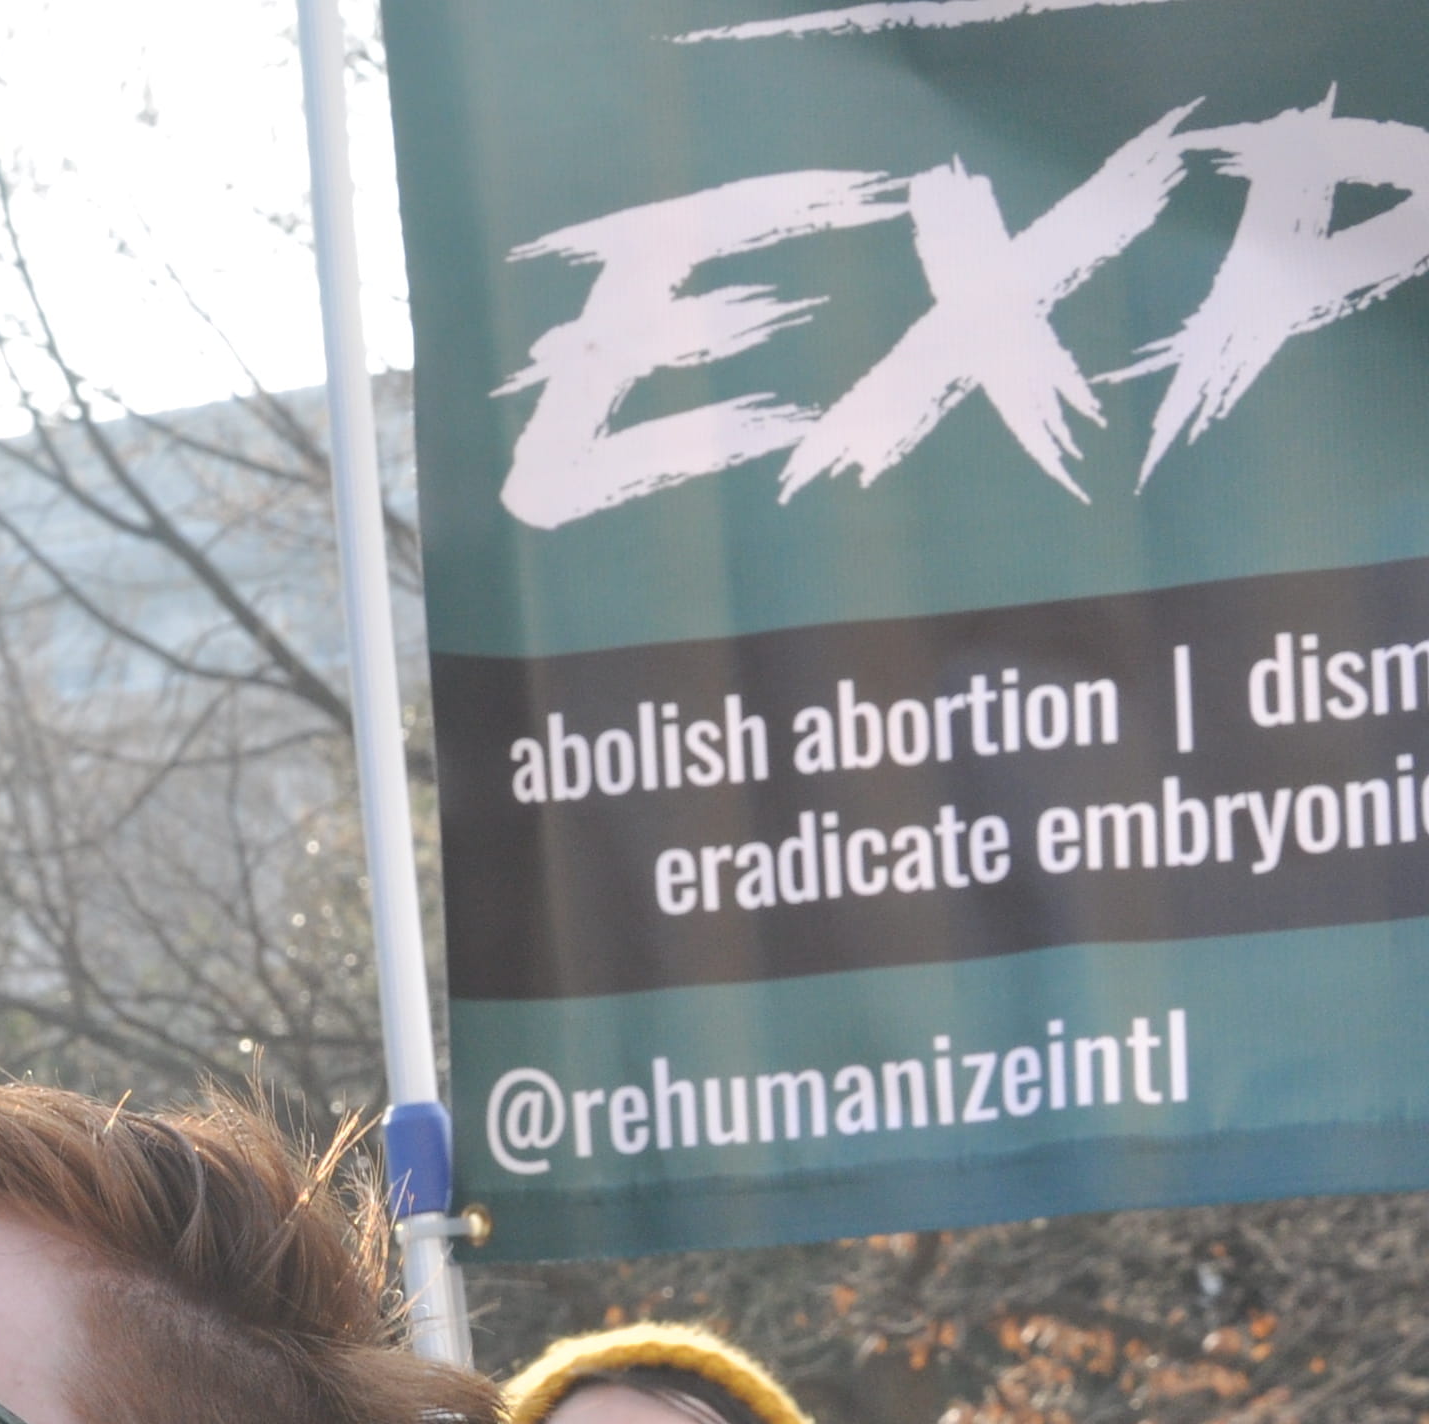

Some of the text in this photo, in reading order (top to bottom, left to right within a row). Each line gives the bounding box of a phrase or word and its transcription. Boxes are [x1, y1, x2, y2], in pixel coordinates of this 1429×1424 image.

[489, 82, 1429, 530] EXP
[510, 693, 769, 803] abolish
[792, 668, 1119, 775] abortion
[654, 754, 1429, 915] eradicate embryoni
[486, 1009, 1188, 1176] @rehumanizeintl
